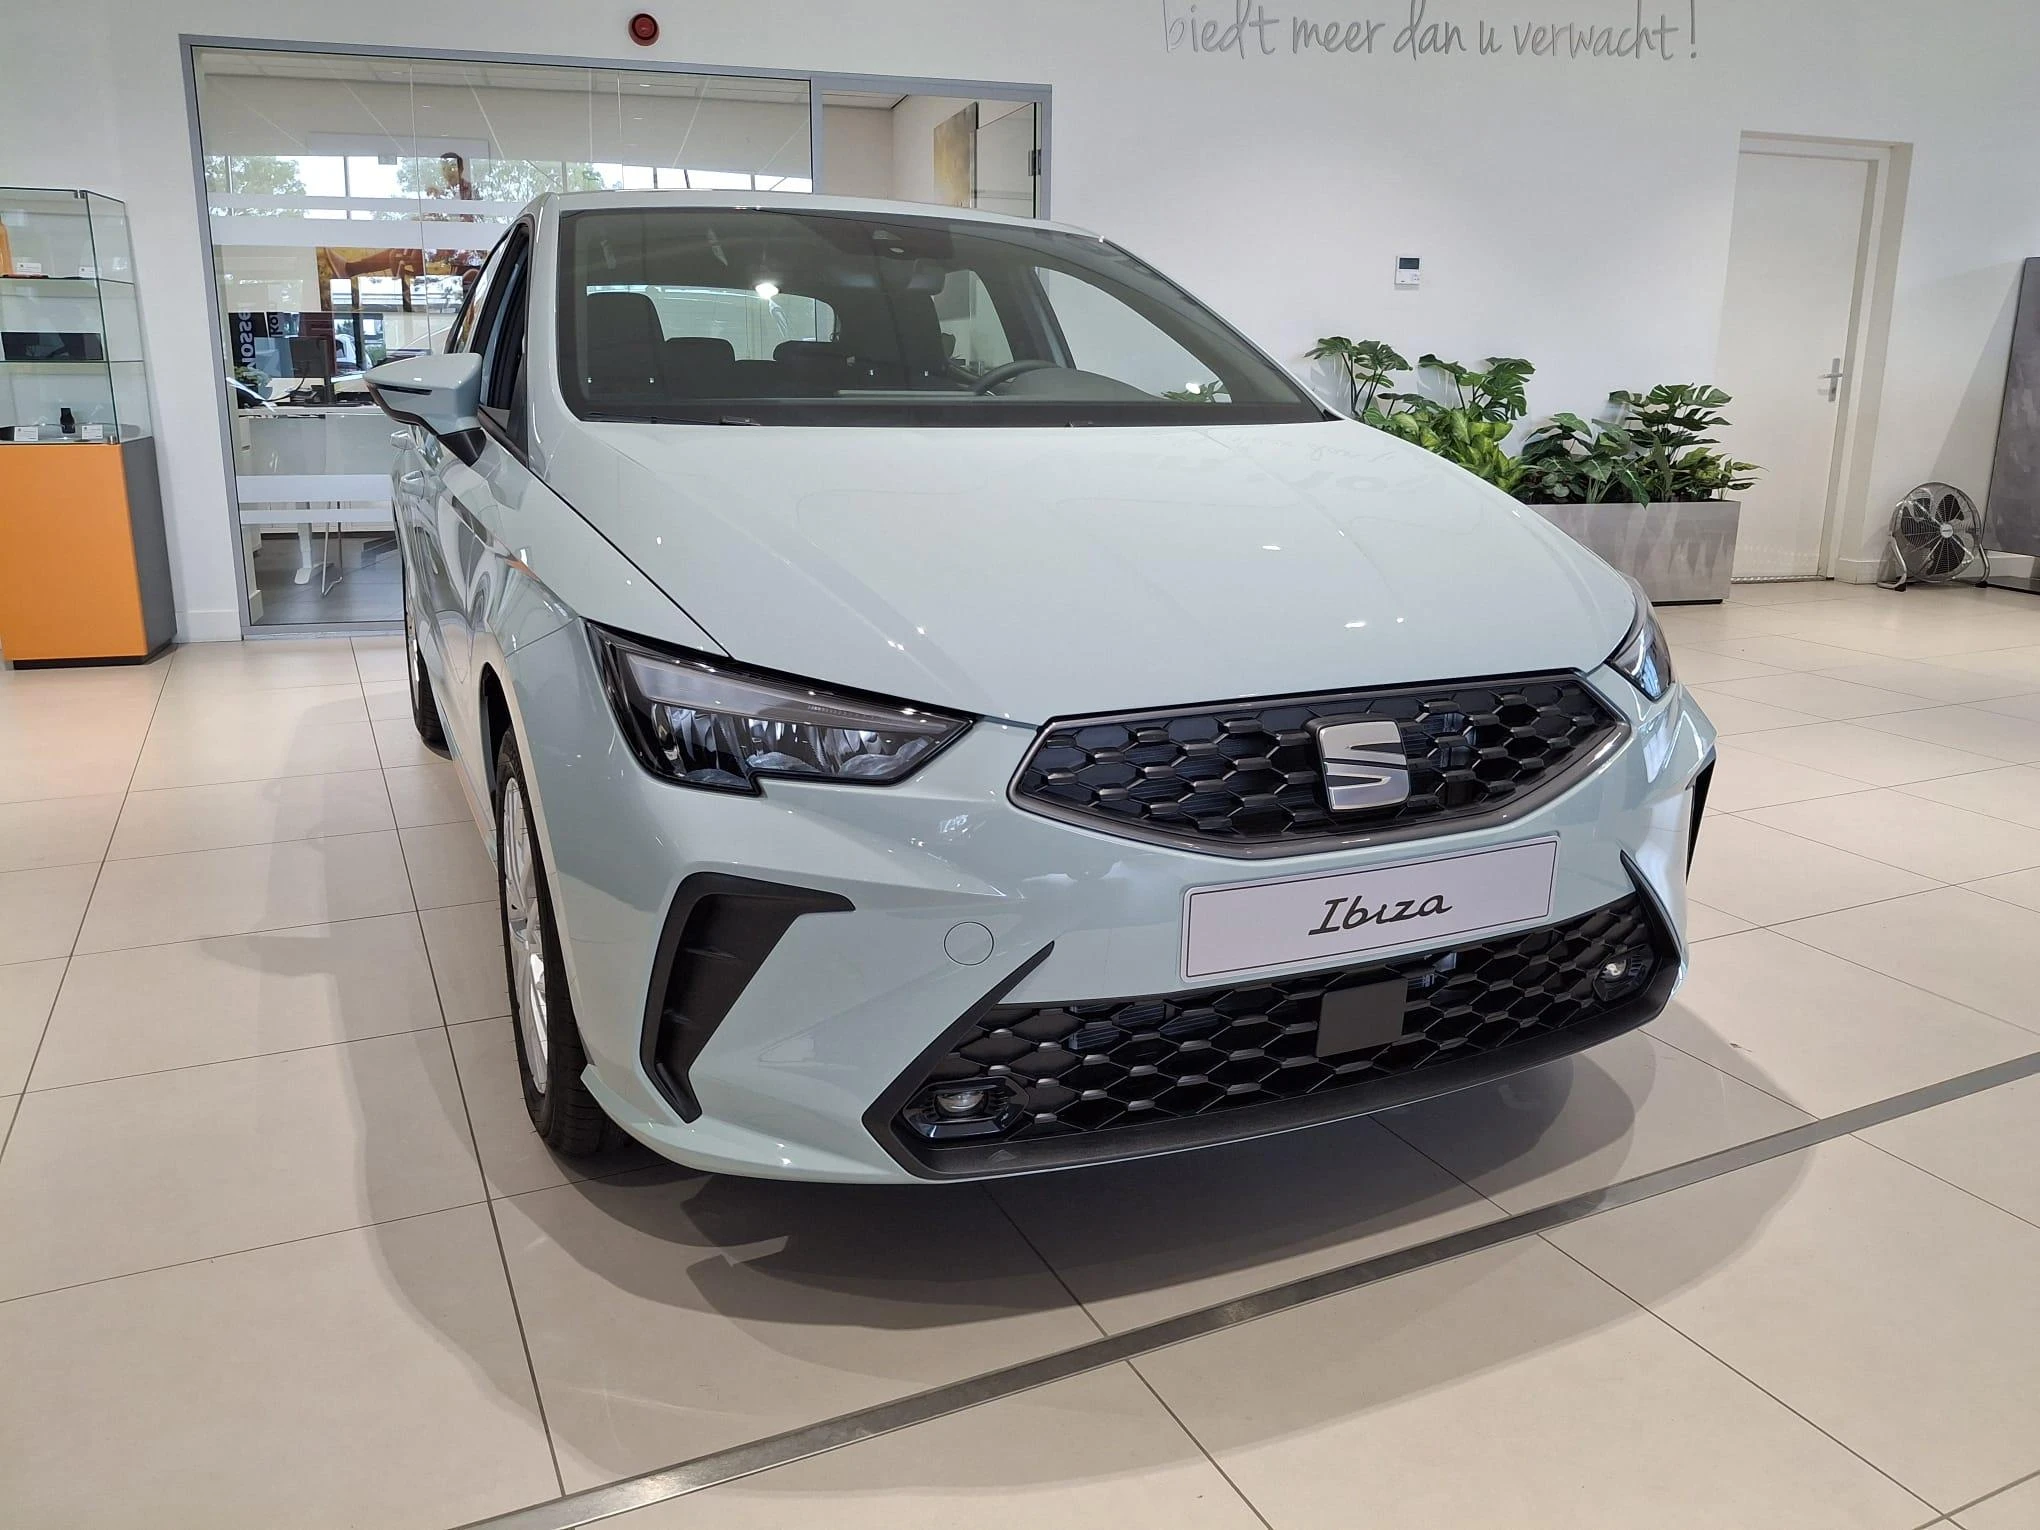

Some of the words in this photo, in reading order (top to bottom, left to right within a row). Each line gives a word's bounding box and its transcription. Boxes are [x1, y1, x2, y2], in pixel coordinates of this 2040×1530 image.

[1163, 0, 1280, 60] biedt
[1292, 16, 1387, 55] meer
[1392, 0, 1468, 61] dan
[1479, 20, 1502, 56] u
[1308, 895, 1453, 936] Ibiza
